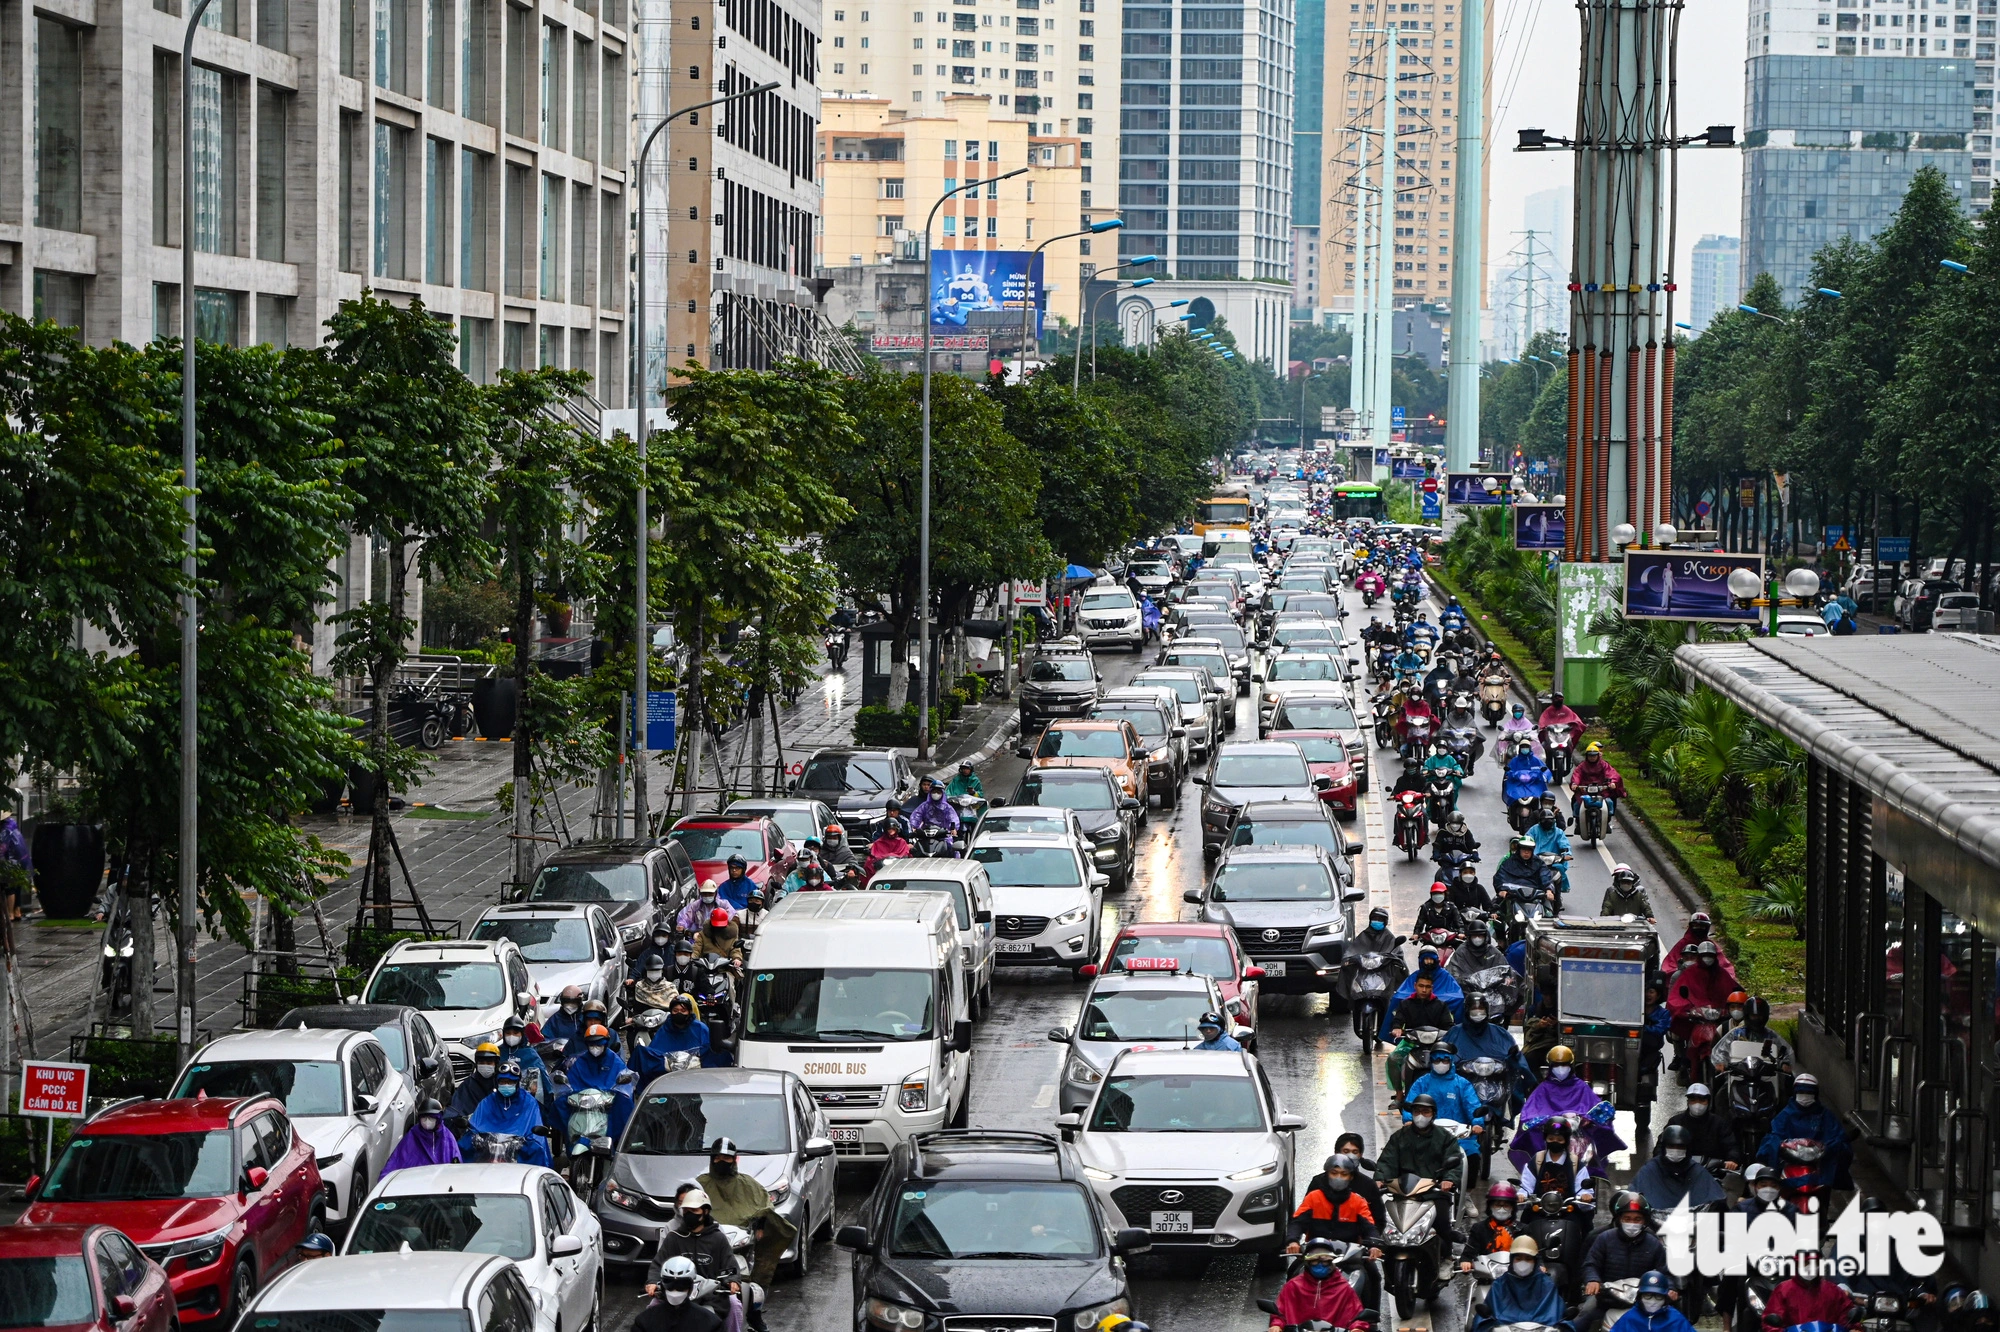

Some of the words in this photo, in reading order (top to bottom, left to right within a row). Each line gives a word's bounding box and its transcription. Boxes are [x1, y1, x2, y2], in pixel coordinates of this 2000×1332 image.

[1130, 958, 1151, 968] Taxi
[1154, 958, 1175, 968] 123
[804, 1062, 843, 1075] SCHOOL
[846, 1062, 867, 1075] BUS
[36, 1069, 55, 1080] KHU
[57, 1070, 75, 1083] VỰC
[42, 1084, 67, 1095] PCCC
[28, 1095, 49, 1109] CẤM
[51, 1097, 64, 1110] ĐỖ
[66, 1101, 78, 1111] XE
[831, 1130, 858, 1141] 08.39
[1163, 1213, 1181, 1222] 30K
[1155, 1222, 1189, 1232] 307.39
